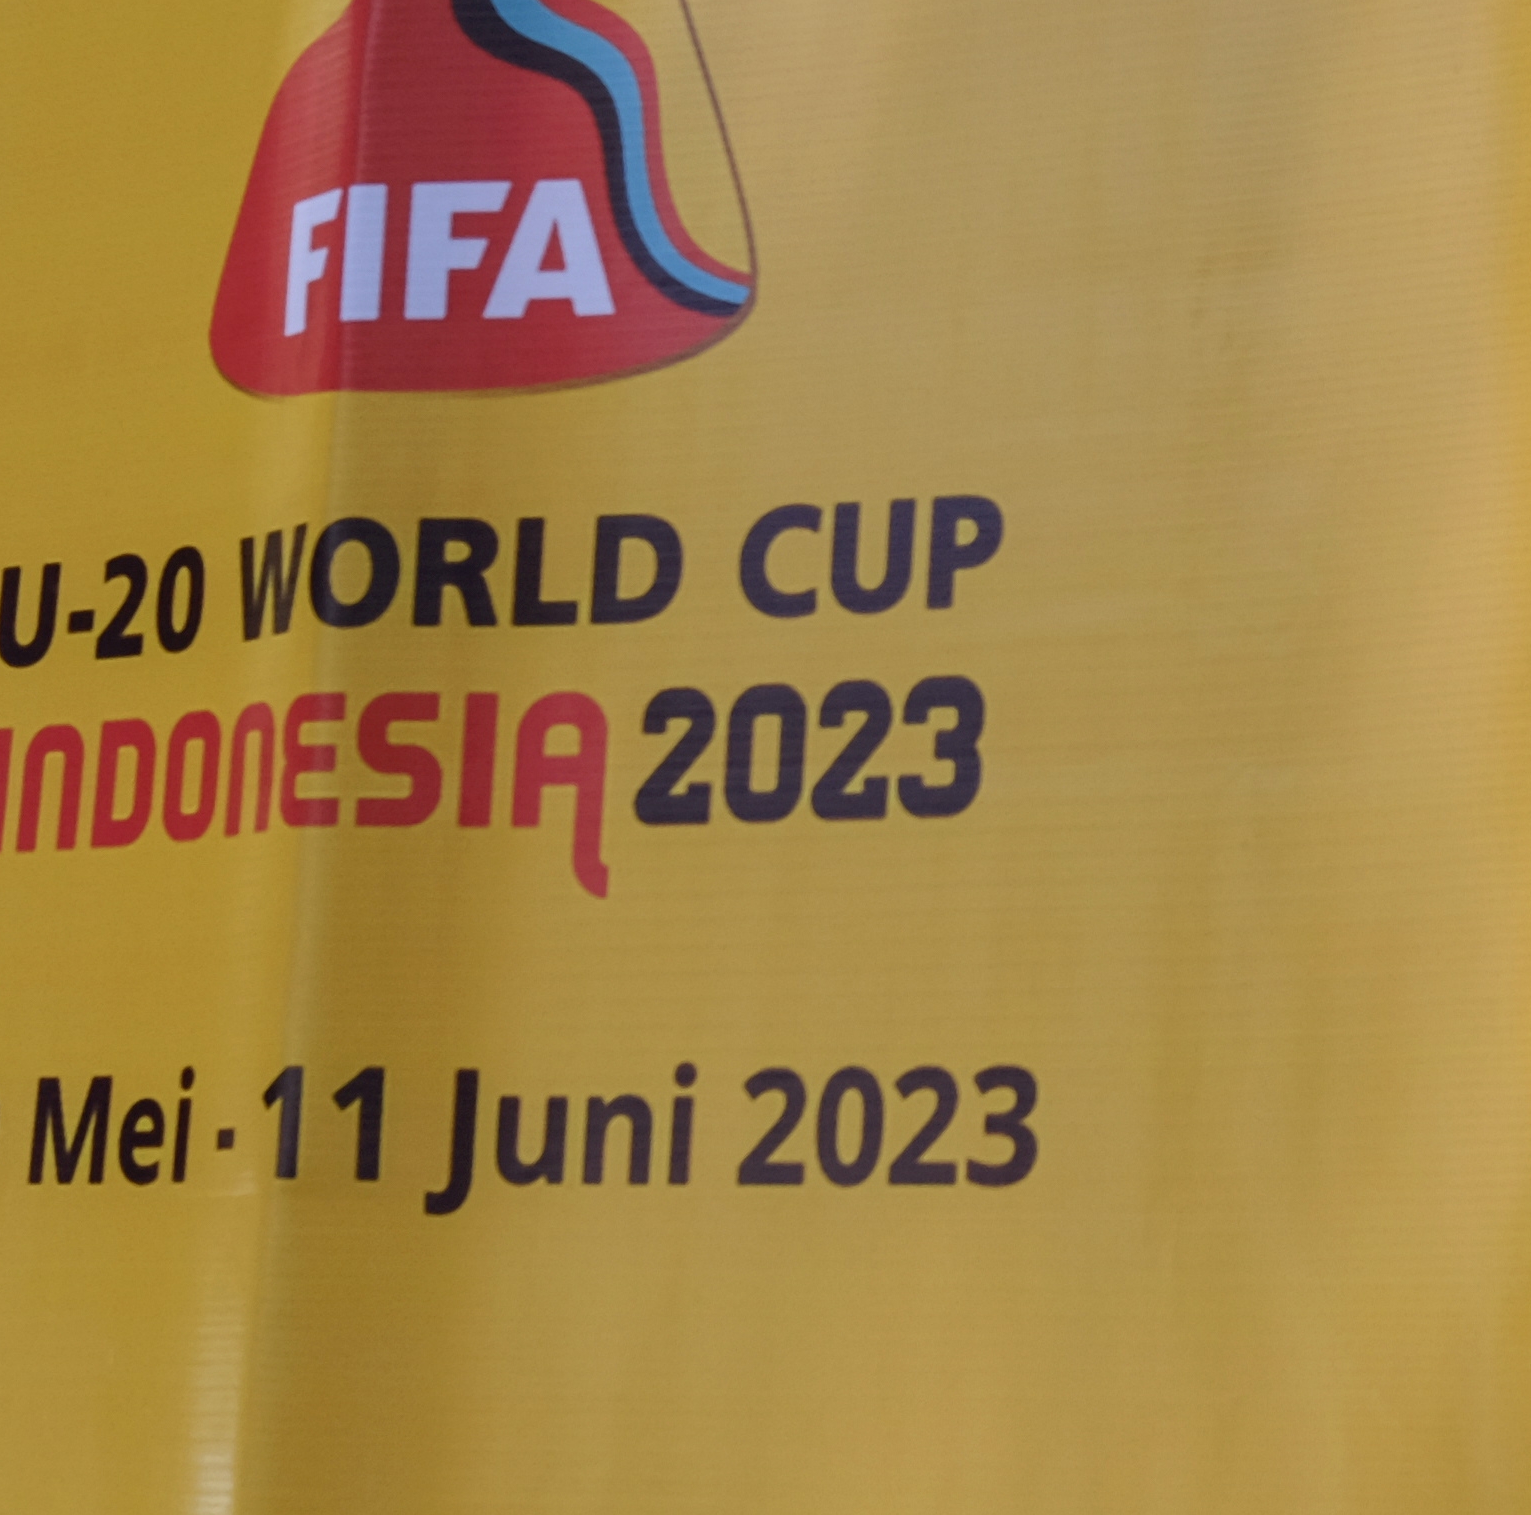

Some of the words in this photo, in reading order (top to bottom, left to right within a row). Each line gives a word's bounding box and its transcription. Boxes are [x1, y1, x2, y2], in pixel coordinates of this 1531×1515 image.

[285, 180, 615, 336] FIFA
[239, 514, 683, 642] WORLD
[739, 495, 1003, 618] CUP
[634, 676, 984, 825] 2023
[27, 1066, 196, 1186] Mei
[262, 1066, 386, 1183] 11
[423, 1062, 697, 1217] Juni
[737, 1066, 1038, 1187] 2023
